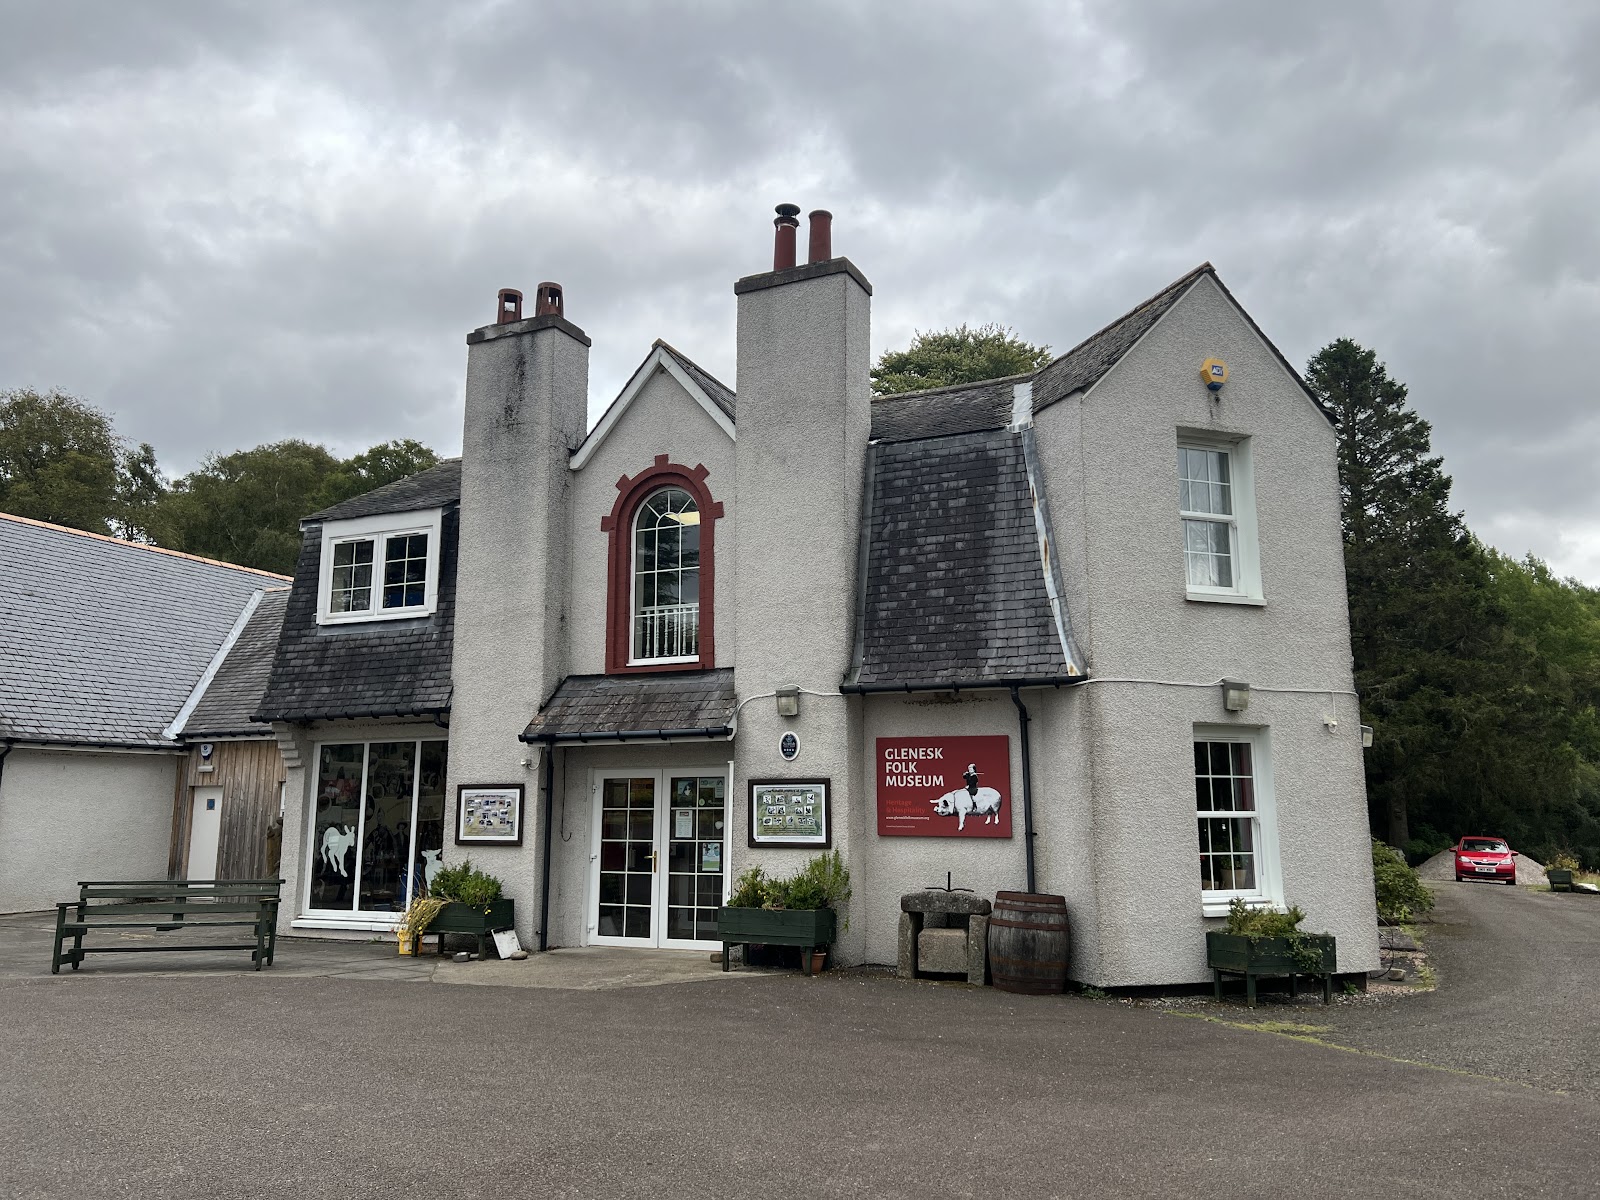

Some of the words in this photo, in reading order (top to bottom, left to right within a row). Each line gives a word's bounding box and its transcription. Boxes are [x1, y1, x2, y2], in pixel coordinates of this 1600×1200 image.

[885, 748, 943, 759] GLENESK
[886, 762, 917, 773] FOLK
[886, 775, 944, 786] MUSEUM
